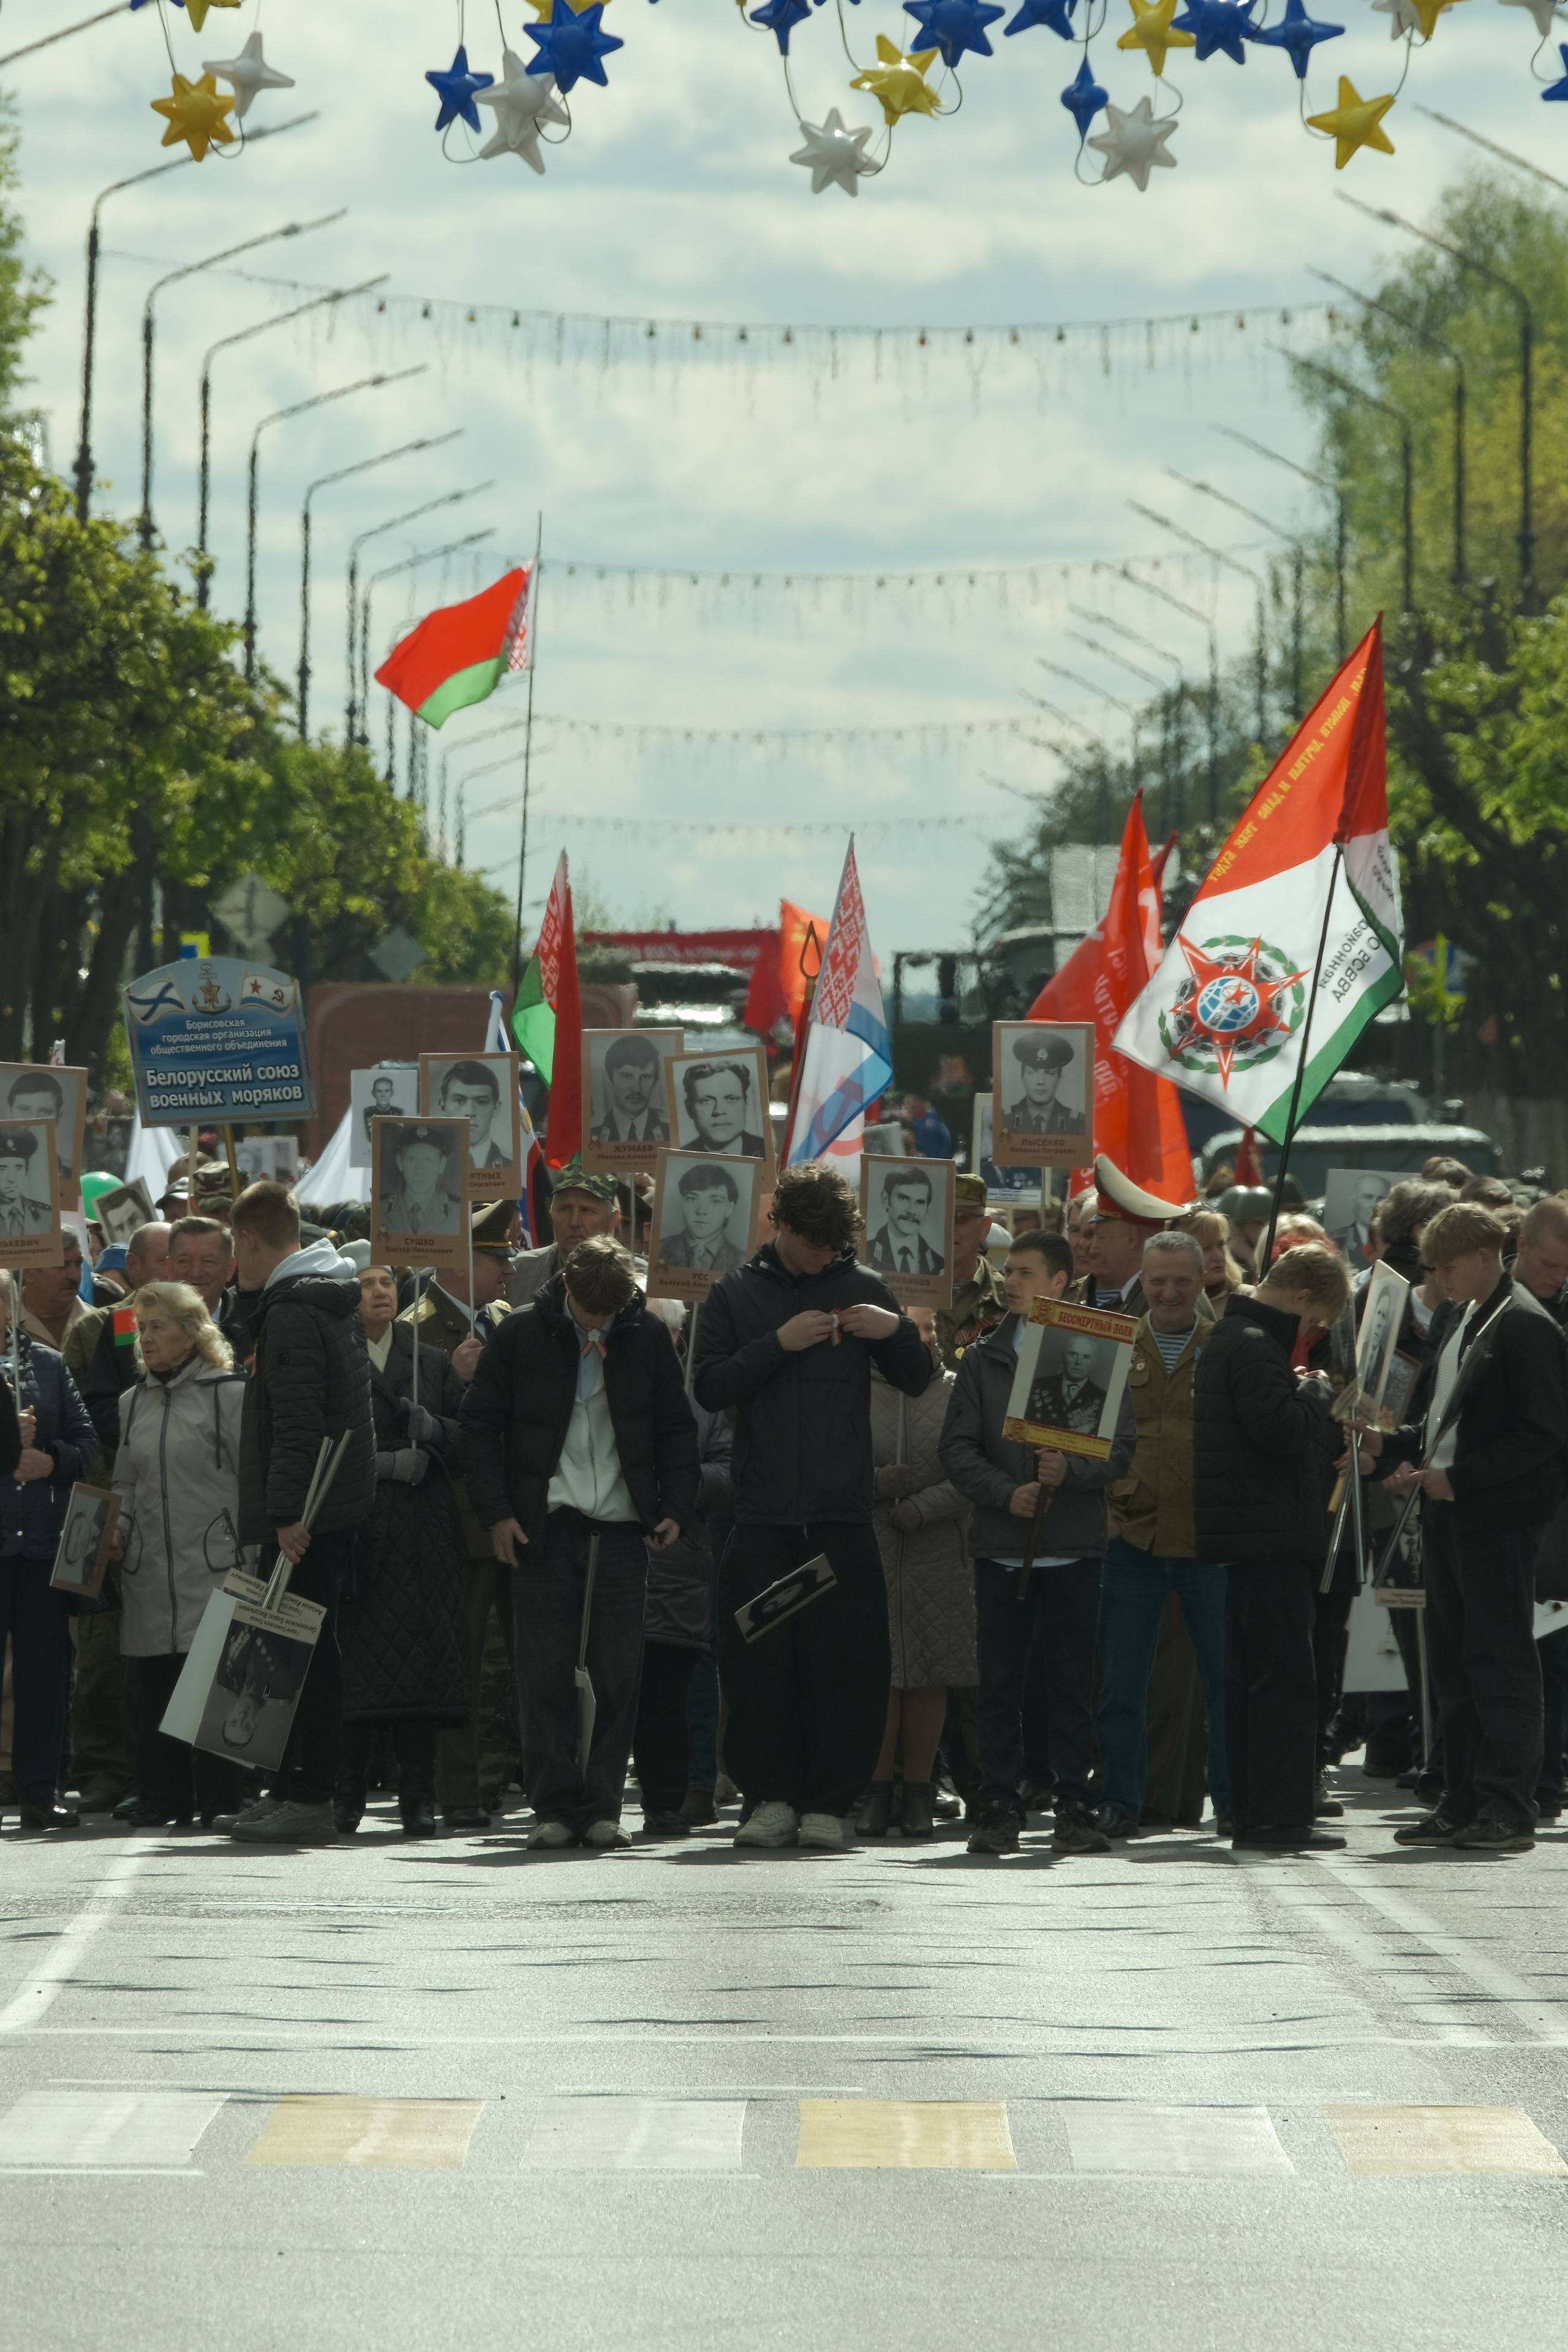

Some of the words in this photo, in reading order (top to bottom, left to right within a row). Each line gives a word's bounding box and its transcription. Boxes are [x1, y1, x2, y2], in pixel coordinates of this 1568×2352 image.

[186, 1019, 245, 1031] Борисовская
[162, 1033, 209, 1044] городская
[212, 1029, 271, 1041] организация
[151, 1043, 222, 1055] общественного
[225, 1039, 287, 1051] объединения
[146, 1063, 252, 1088] Белорусский
[257, 1064, 299, 1080] союз
[149, 1089, 224, 1107] военных
[232, 1085, 303, 1106] моряков
[404, 1237, 434, 1246] СУШКО
[692, 1272, 709, 1281] УСС
[885, 1275, 930, 1286] ОРОВИКОВ
[1058, 1311, 1112, 1334] БЕССМЕРТНЫЙ
[1114, 1324, 1133, 1337] ПОЛК
[238, 1605, 267, 1618] Васильевич
[302, 1600, 323, 1616] Анохин
[250, 1615, 263, 1624] Союза
[268, 1613, 285, 1625] Борис
[287, 1626, 300, 1636] Герой
